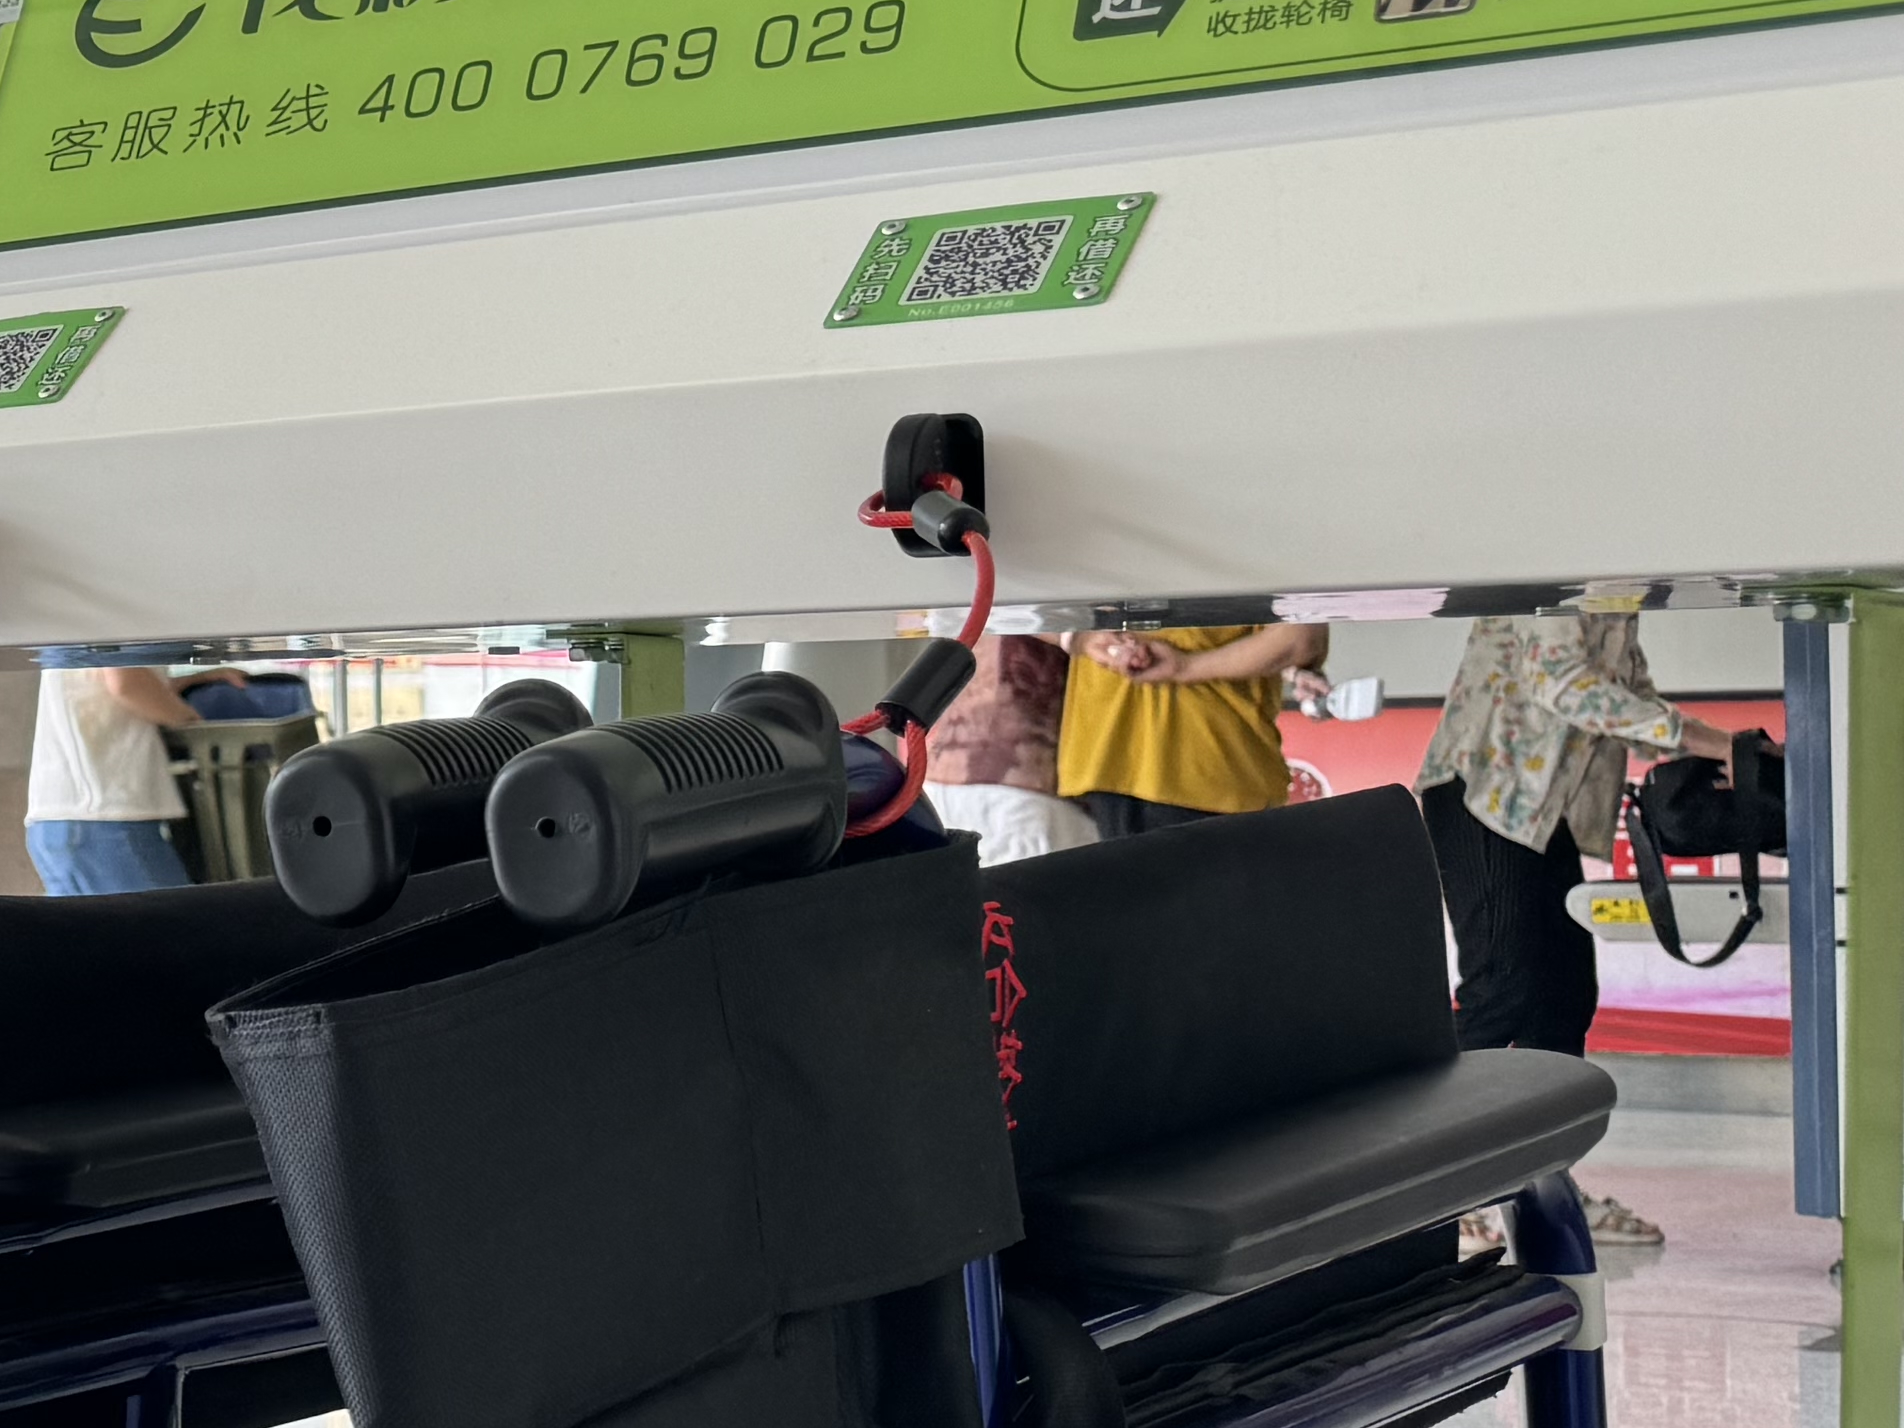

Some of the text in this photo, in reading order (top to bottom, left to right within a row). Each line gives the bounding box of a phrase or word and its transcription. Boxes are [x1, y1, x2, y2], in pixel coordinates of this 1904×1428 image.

[44, 82, 330, 172] 客服热线
[357, 58, 493, 124] 400
[525, 25, 718, 102] 0769
[848, 236, 912, 306] 先扫码
[1063, 212, 1131, 287] 再借还
